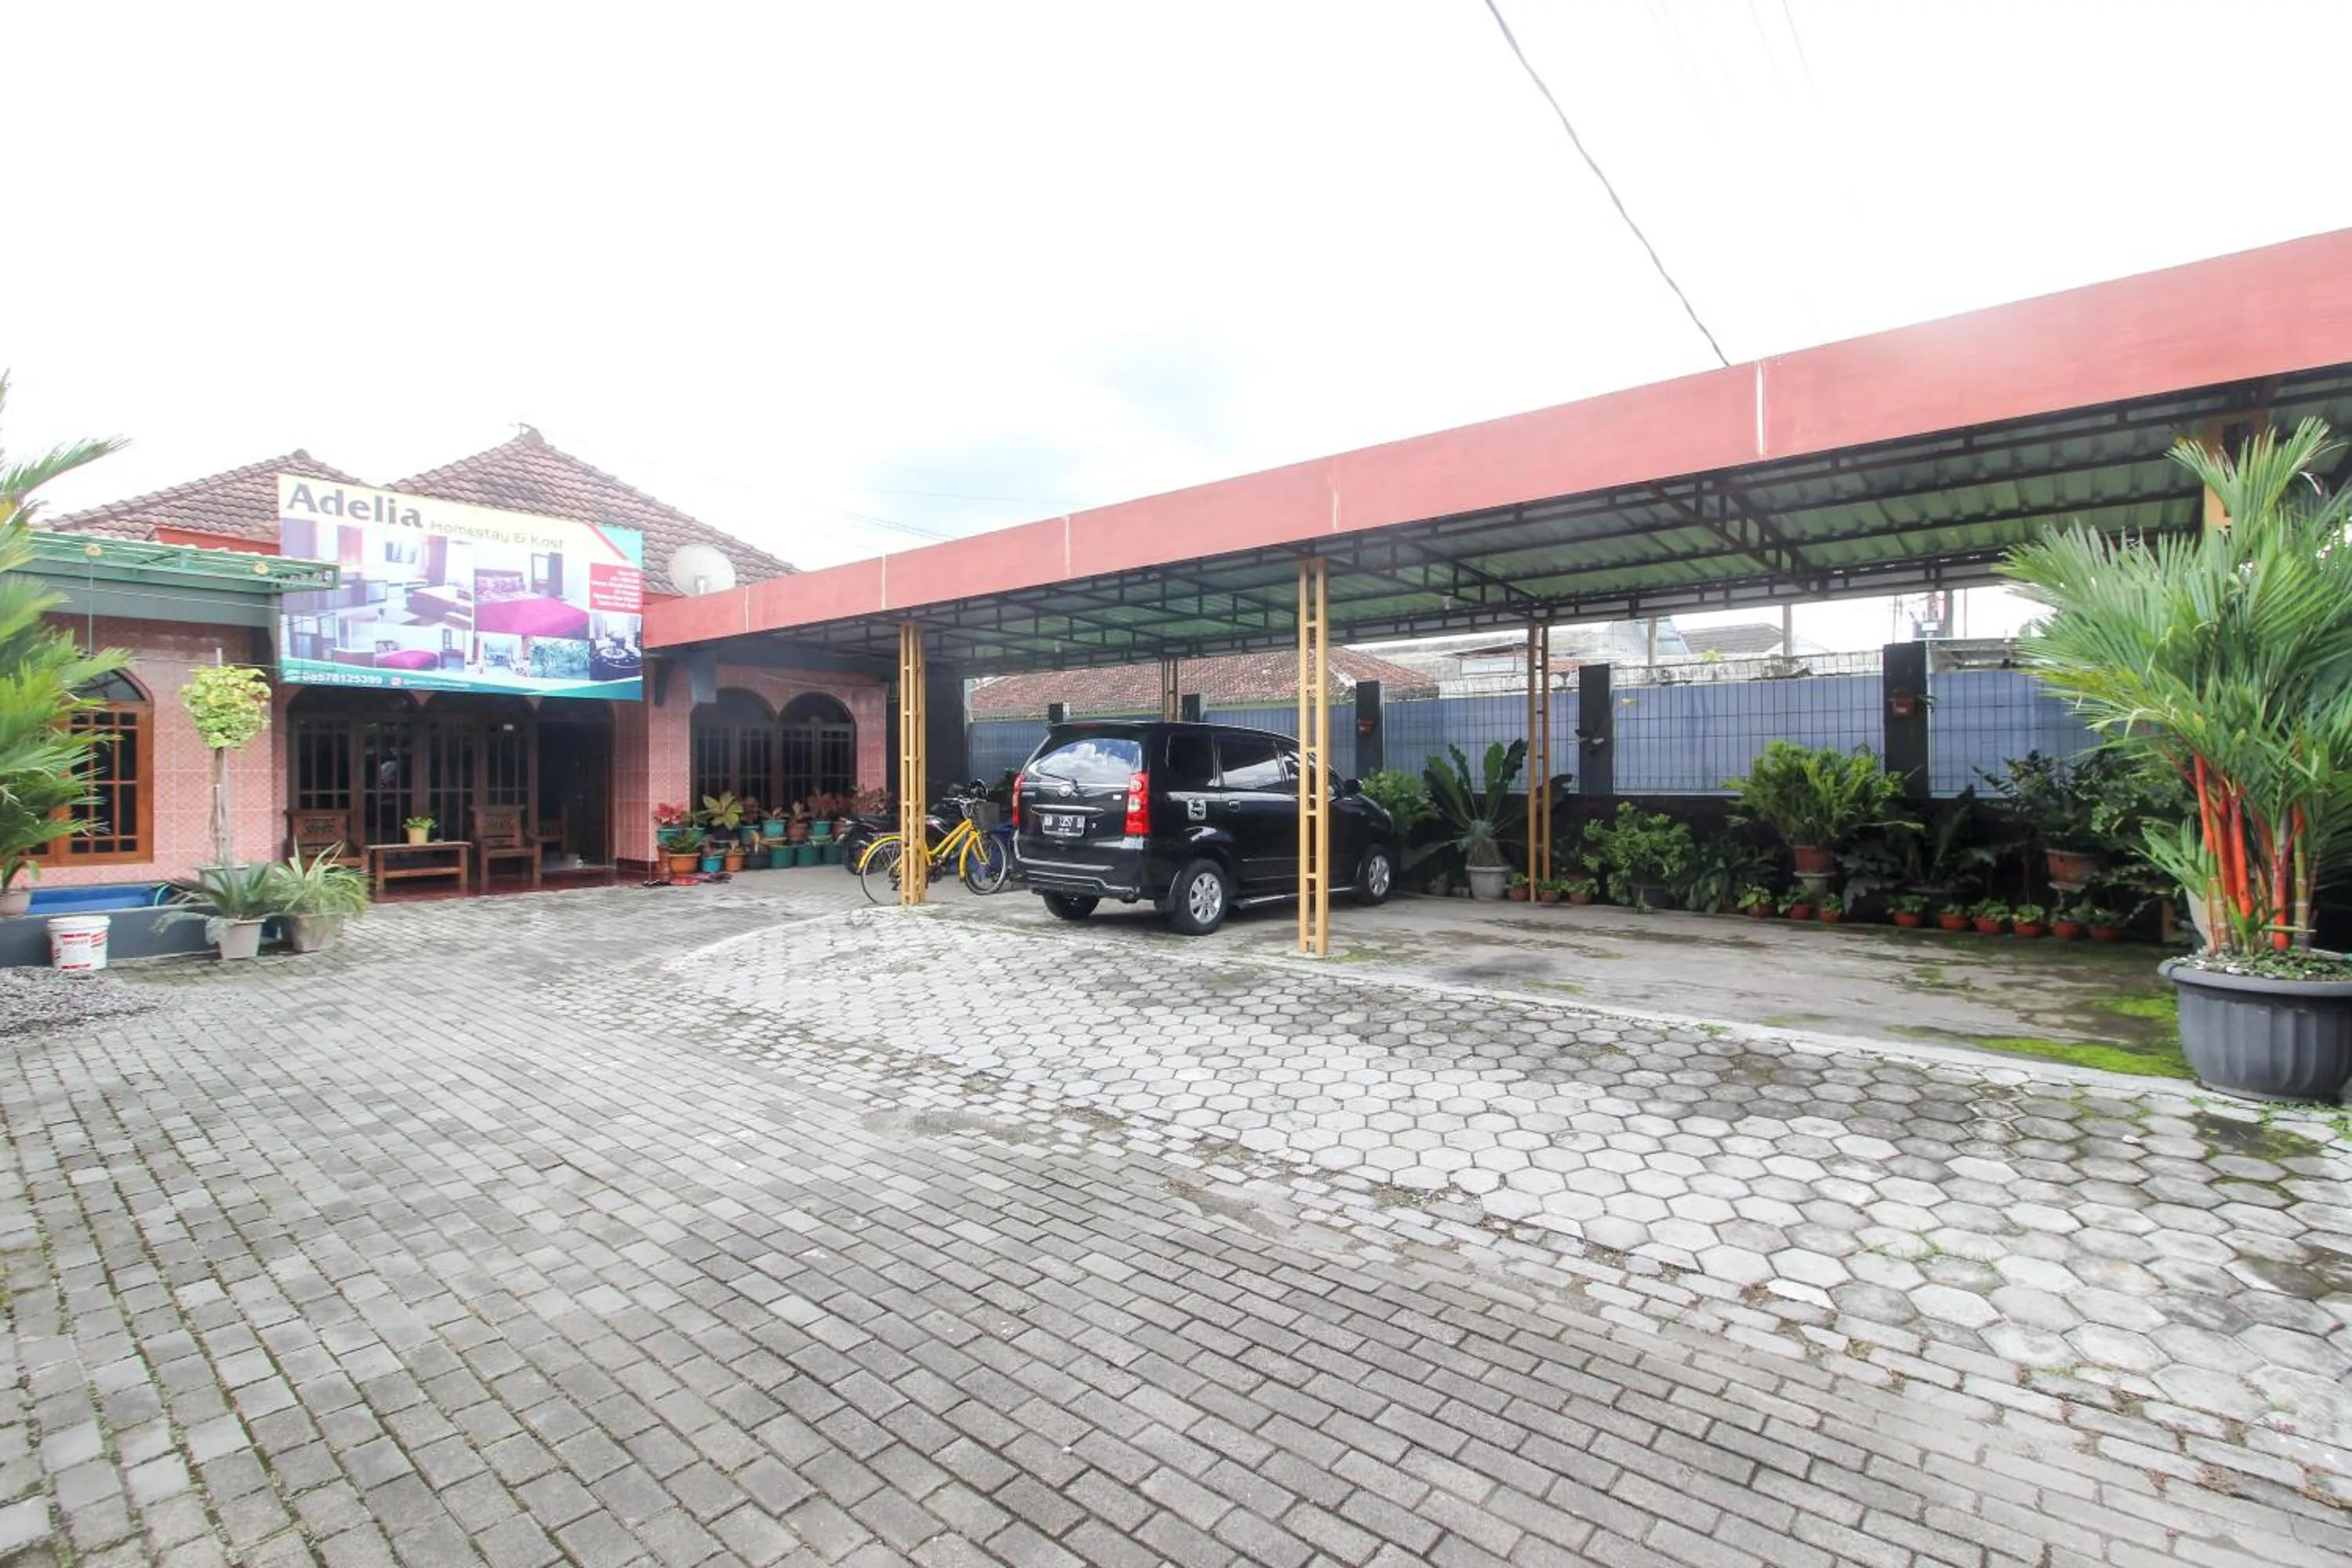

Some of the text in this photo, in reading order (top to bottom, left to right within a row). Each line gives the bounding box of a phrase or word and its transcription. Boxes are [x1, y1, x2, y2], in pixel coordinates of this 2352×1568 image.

[286, 483, 564, 549] Adelia Homestay & Kost
